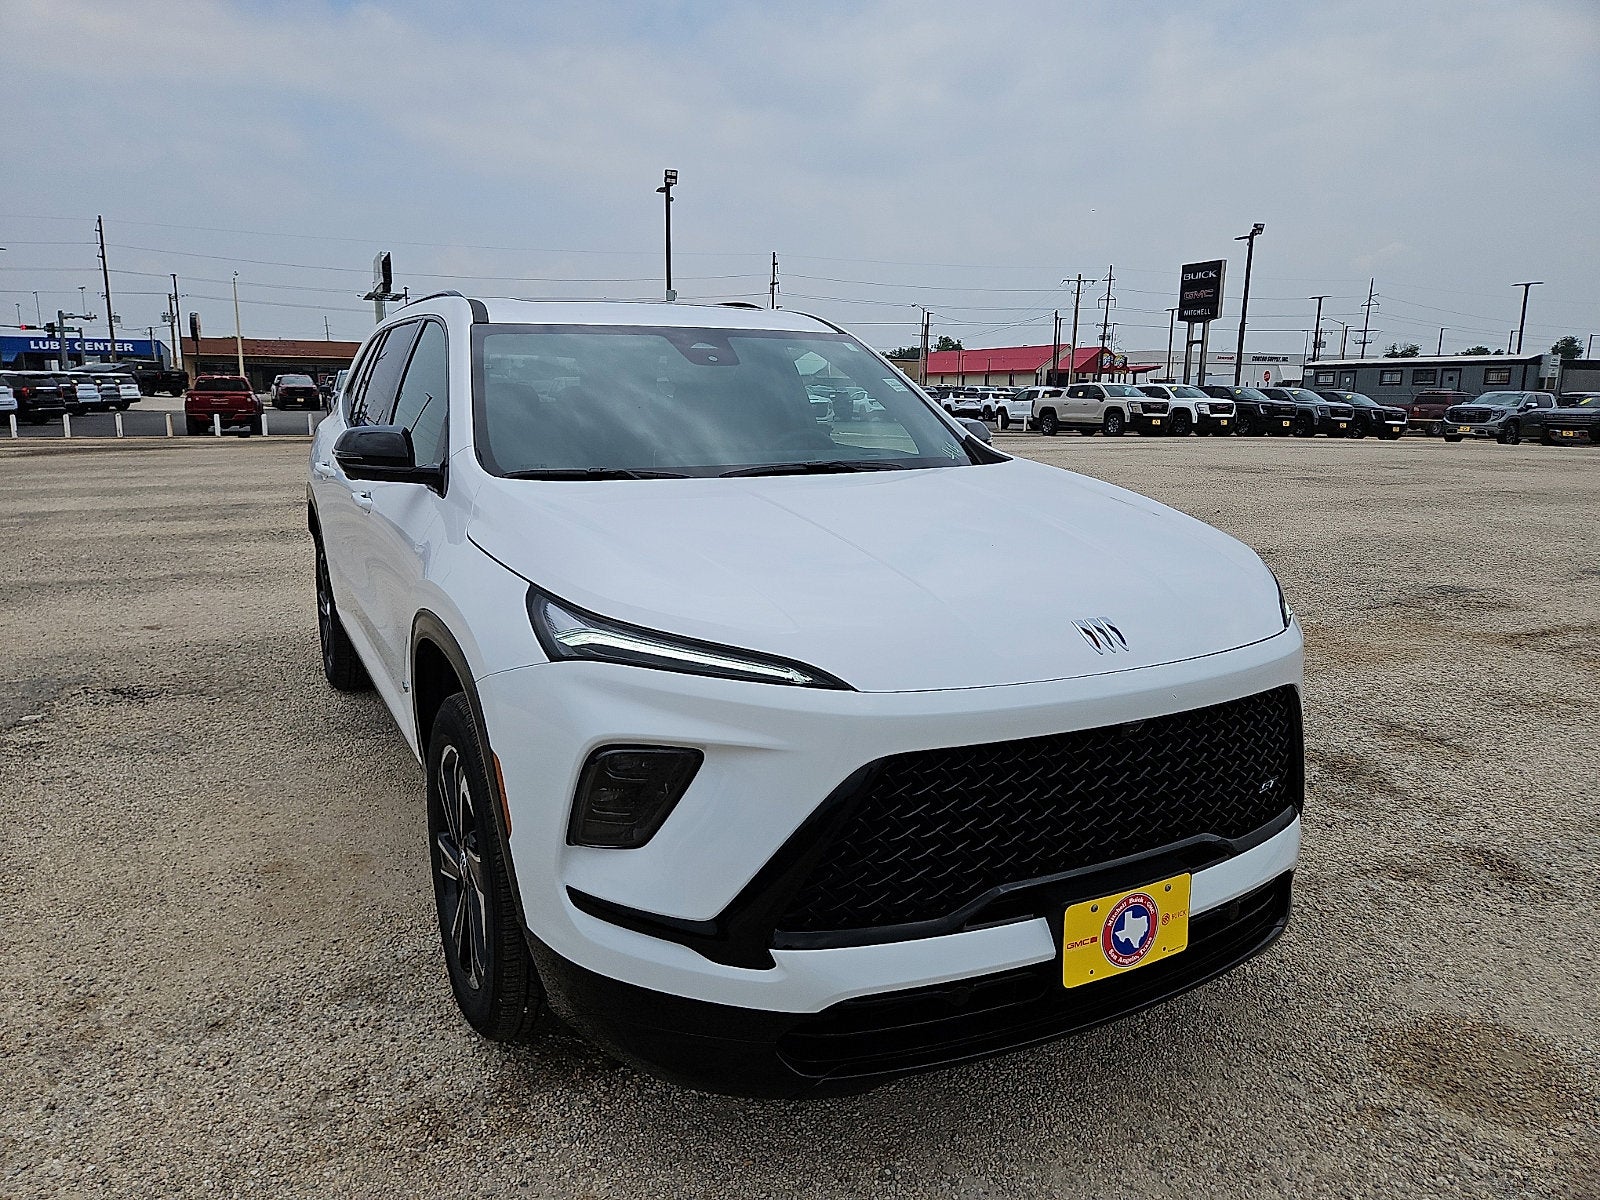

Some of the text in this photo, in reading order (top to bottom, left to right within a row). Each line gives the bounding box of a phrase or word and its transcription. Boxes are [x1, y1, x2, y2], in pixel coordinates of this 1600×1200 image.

[1183, 270, 1218, 281] BUICK
[1183, 289, 1214, 300] GMC
[29, 340, 135, 352] LUBE CENTER
[1128, 896, 1144, 904] Buick
[1066, 938, 1090, 950] GMC
[1108, 948, 1118, 961] San
